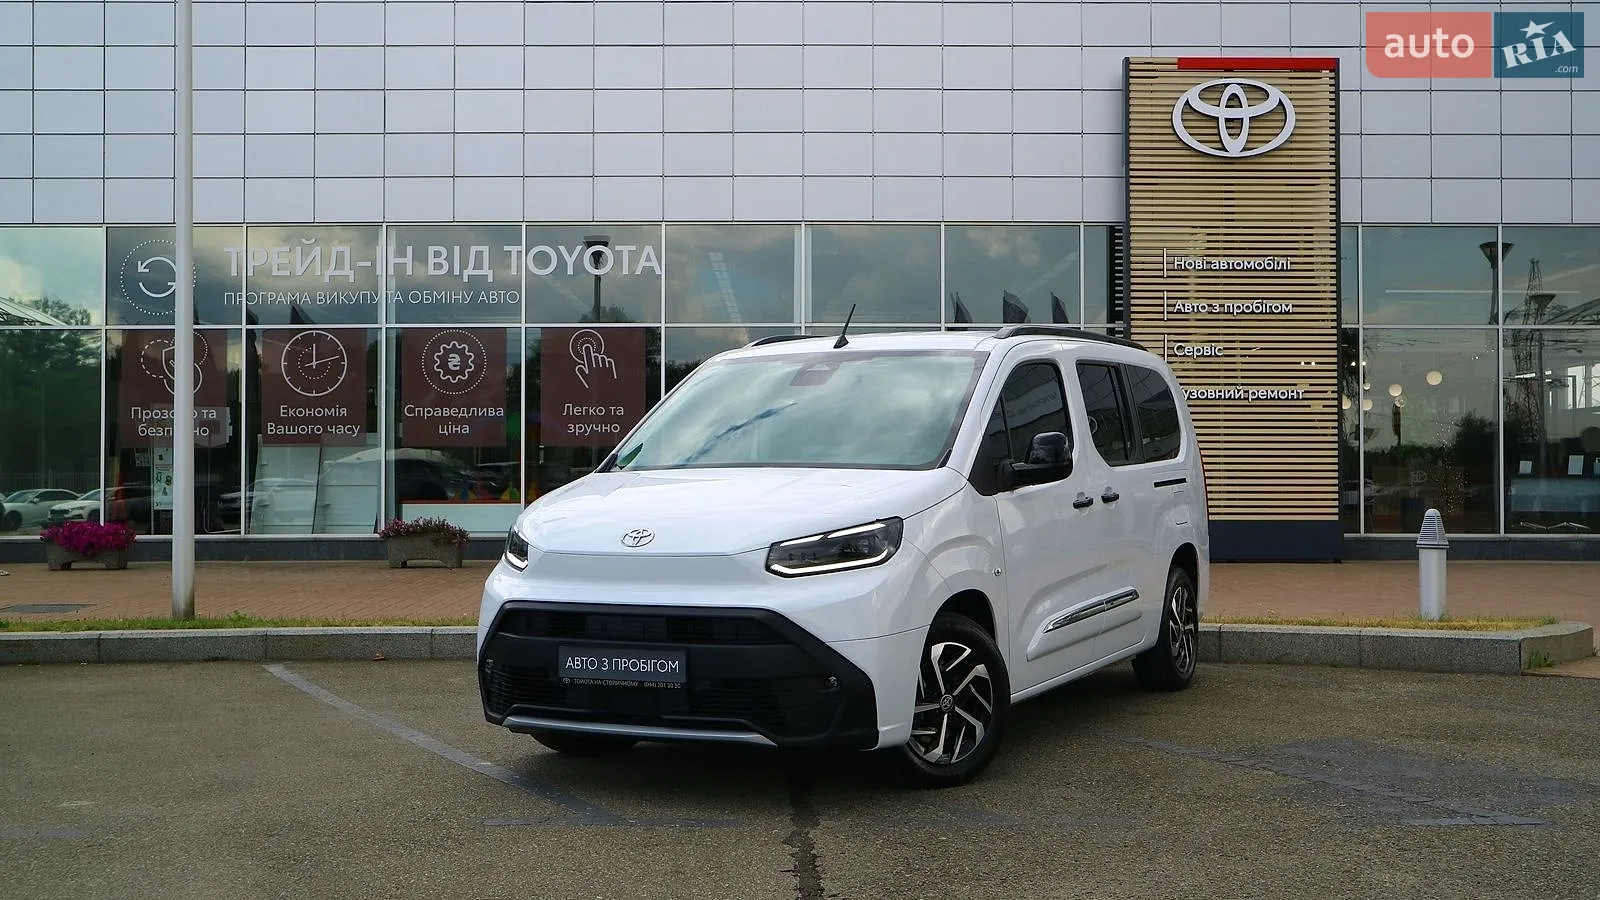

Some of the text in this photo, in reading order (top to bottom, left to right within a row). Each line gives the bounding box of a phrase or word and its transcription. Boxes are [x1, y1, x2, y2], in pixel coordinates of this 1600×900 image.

[223, 238, 663, 283] ТРЕЙД-ІН ВІД TOYOTA
[1173, 256, 1291, 270] Нові автомобілі
[224, 290, 520, 305] ПРОГРАМА ВИКУПУ ТА ОБМІНУ АВТО
[1173, 300, 1293, 317] Авто з пробігом
[1173, 343, 1224, 358] Сервіс
[1180, 386, 1305, 403] узовний ремонт
[131, 406, 217, 422] Прозо та
[280, 405, 347, 417] Економія
[404, 404, 504, 418] Справедлива
[562, 404, 625, 416] Легко та
[138, 423, 210, 436] безпно
[267, 423, 361, 437] Вашого часу
[438, 421, 470, 435] ціна
[567, 423, 620, 436] зручно
[565, 656, 598, 670] АВТО
[612, 658, 680, 673] ПРОБІГОМ
